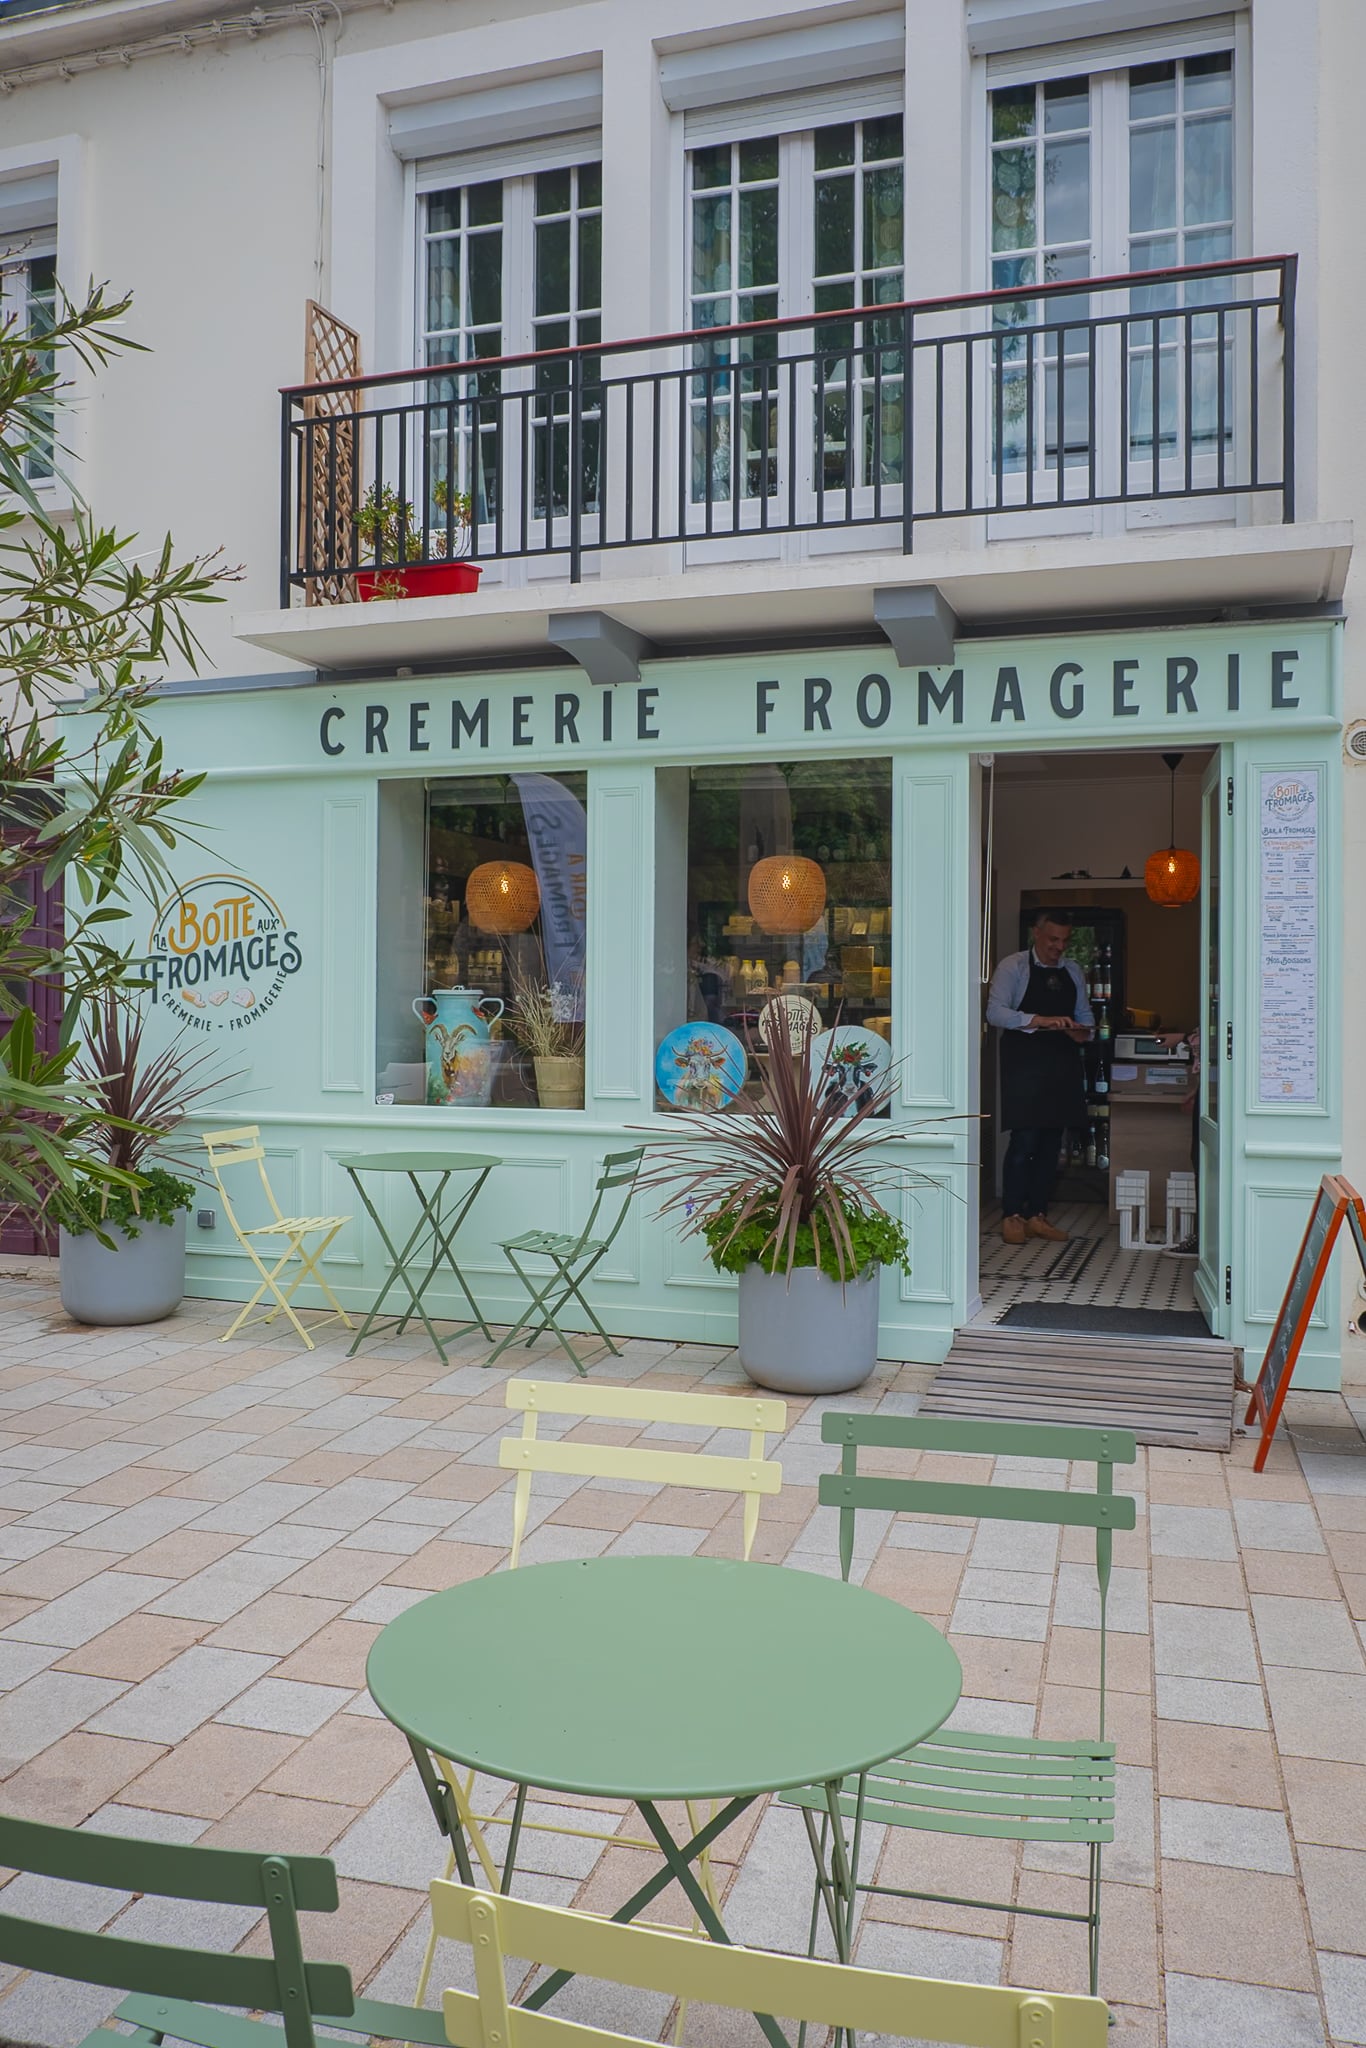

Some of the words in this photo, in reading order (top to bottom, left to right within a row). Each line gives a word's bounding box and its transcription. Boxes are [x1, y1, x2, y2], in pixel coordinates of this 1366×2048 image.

[320, 687, 660, 756] CREMERIE
[756, 650, 1300, 735] FROMAGERIE
[1265, 791, 1315, 812] FROMAGES
[153, 933, 168, 951] LA
[257, 918, 280, 933] AUX
[140, 931, 302, 1004] FROMAGES
[230, 970, 287, 1031] FROMAGERIE
